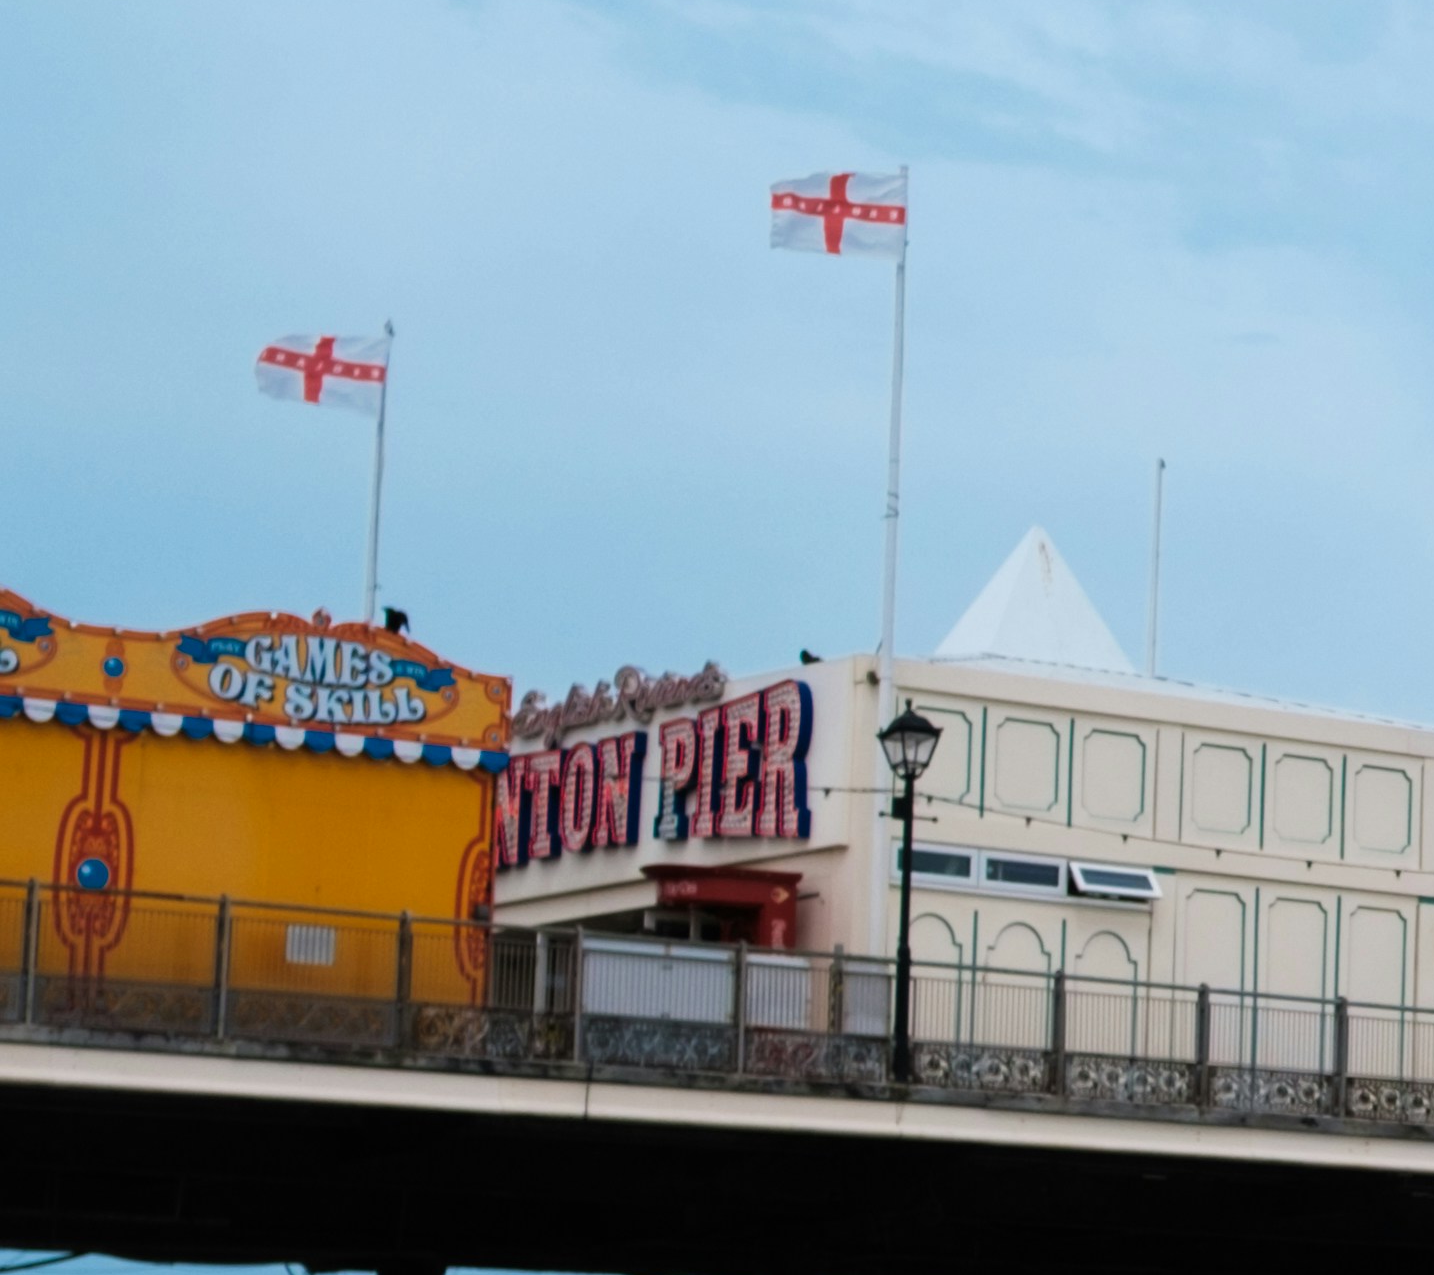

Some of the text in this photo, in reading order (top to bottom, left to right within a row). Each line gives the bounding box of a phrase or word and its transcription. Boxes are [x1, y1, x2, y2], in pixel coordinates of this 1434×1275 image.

[245, 634, 394, 687] GAMES
[208, 662, 426, 725] OF SKILL
[653, 679, 814, 840] PIER
